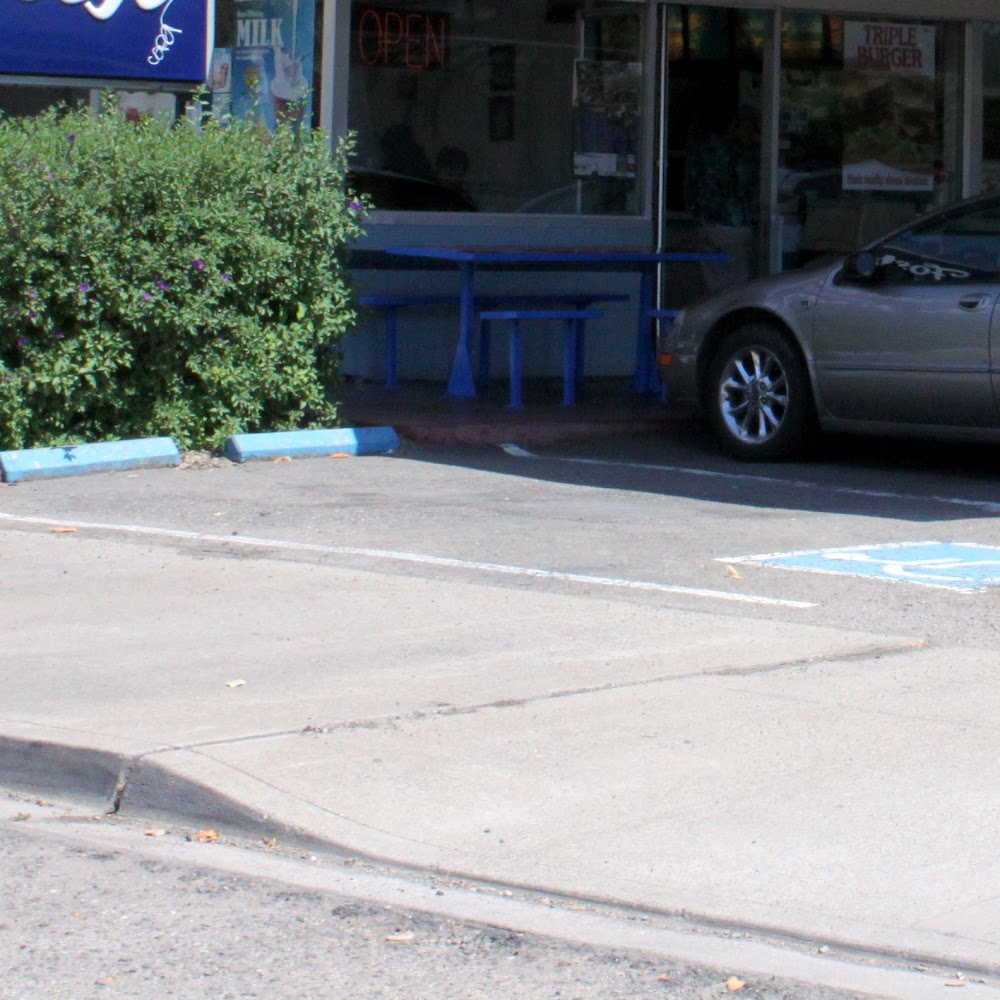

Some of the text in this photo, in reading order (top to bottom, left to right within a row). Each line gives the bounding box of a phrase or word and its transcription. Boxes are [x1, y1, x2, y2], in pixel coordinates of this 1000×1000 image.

[236, 18, 285, 47] MILK
[359, 9, 446, 70] OPEN
[864, 24, 918, 46] TRIPLE
[857, 45, 923, 69] BURGER
